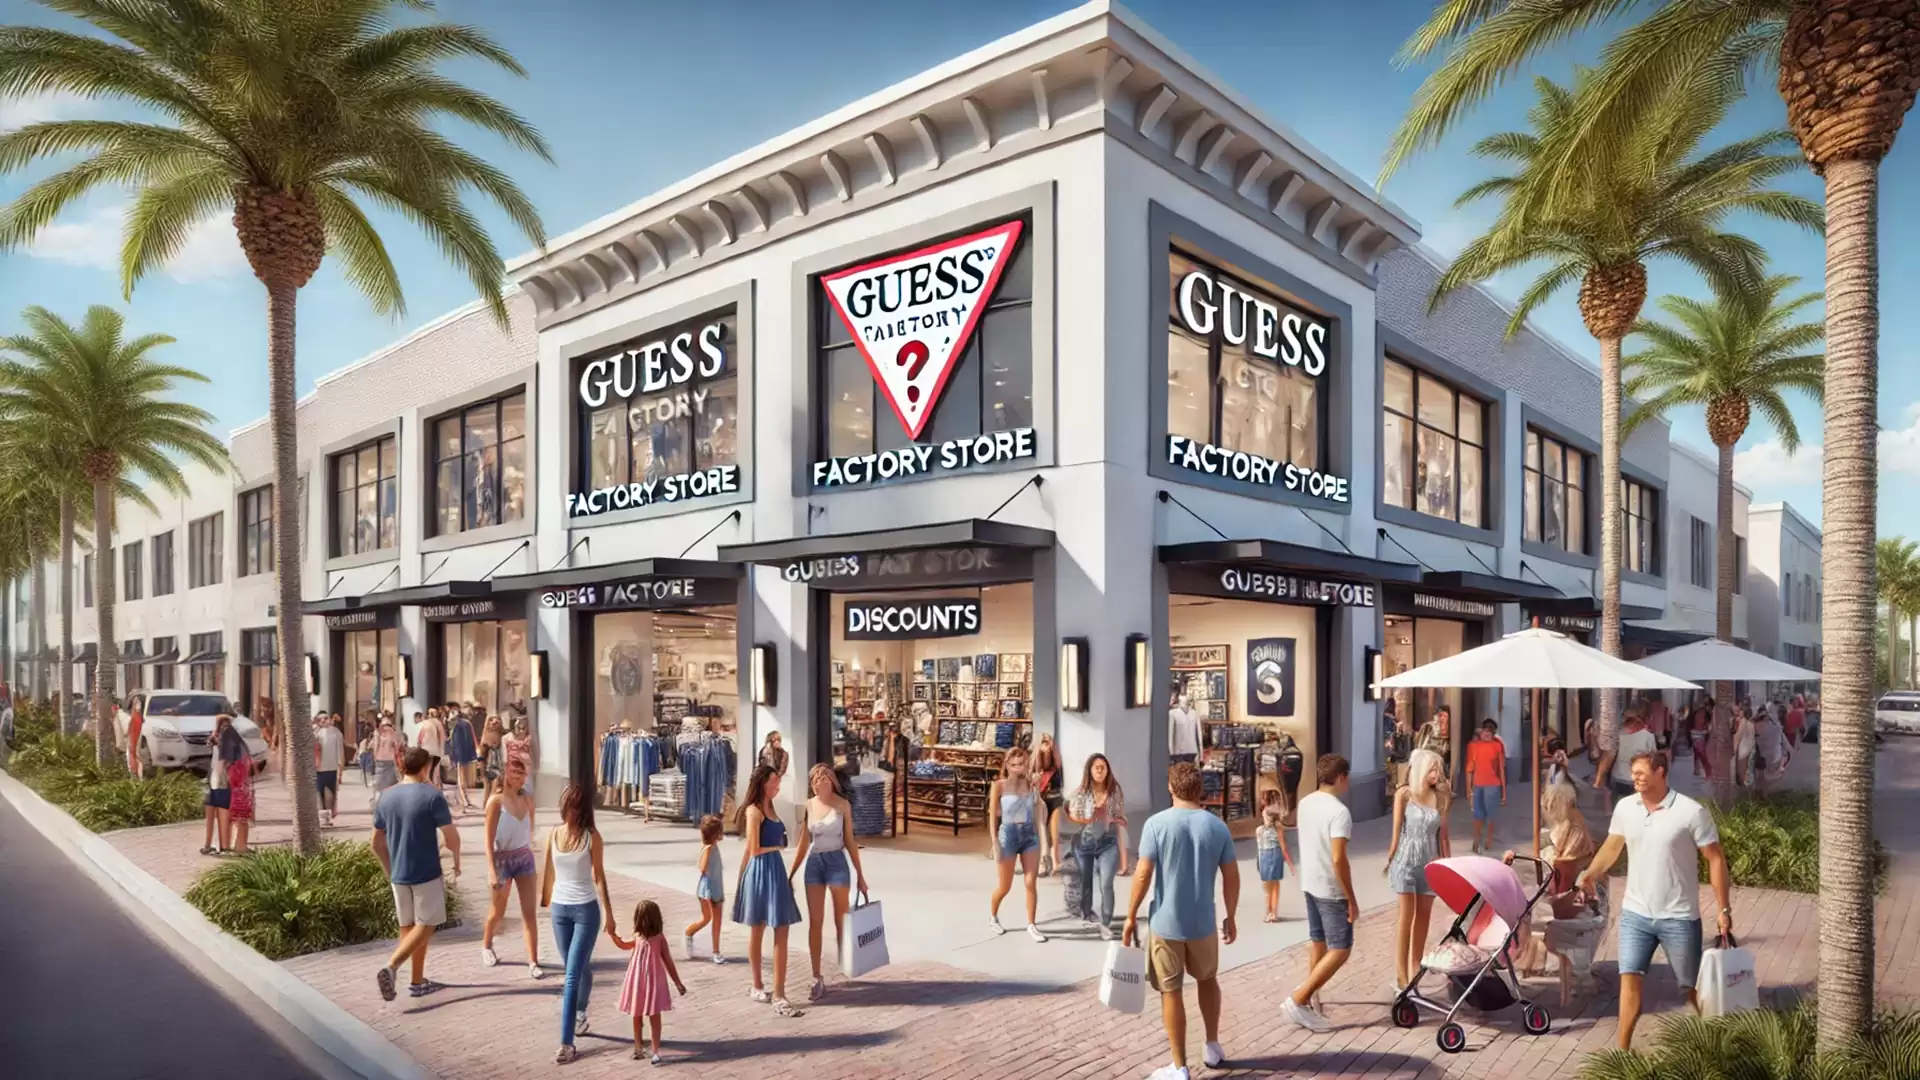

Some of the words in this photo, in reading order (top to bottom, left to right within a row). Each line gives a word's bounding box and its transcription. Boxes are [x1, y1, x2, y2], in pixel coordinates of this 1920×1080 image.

[846, 249, 985, 318] GUESS
[1179, 271, 1327, 377] GUESS
[579, 322, 725, 408] GUESS
[814, 446, 933, 487] FACTORY
[941, 427, 1034, 469] STORE
[1168, 435, 1279, 485] FACTORY
[565, 478, 658, 516] FACTORY
[663, 464, 738, 501] STORE
[849, 604, 978, 633] DISCOUNTS
